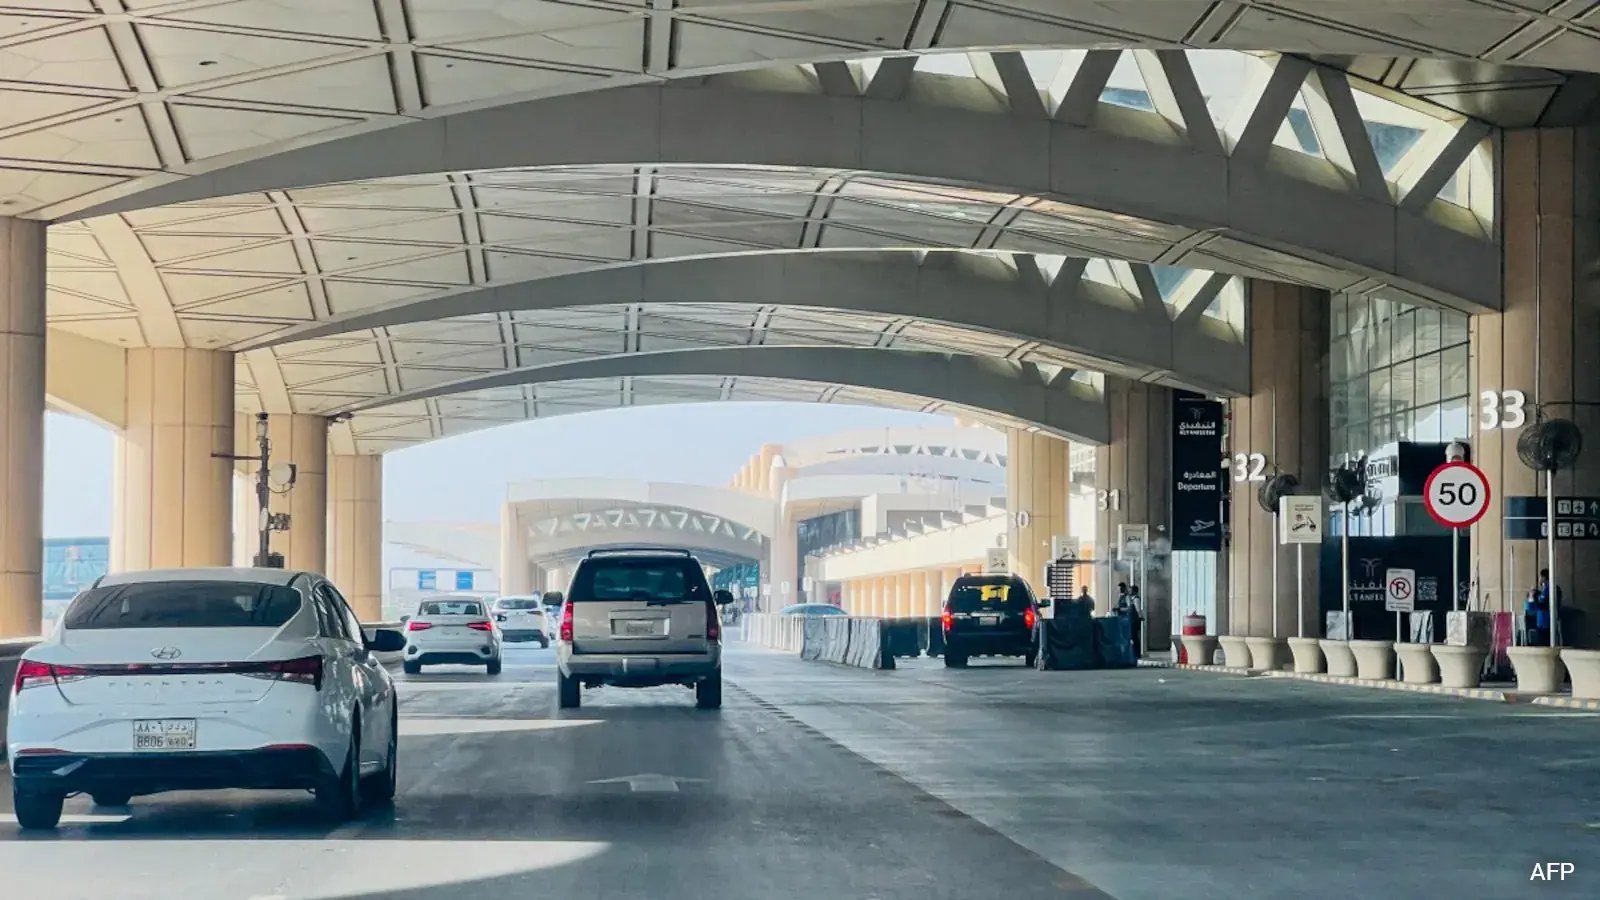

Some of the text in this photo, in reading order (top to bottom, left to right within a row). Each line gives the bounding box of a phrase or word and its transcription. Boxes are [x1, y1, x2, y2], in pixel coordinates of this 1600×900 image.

[1480, 390, 1525, 430] 33
[1234, 453, 1266, 481] 32
[1177, 482, 1216, 492] Departure
[1438, 483, 1476, 506] 50
[1097, 489, 1120, 511] 31
[137, 736, 163, 747] 8806
